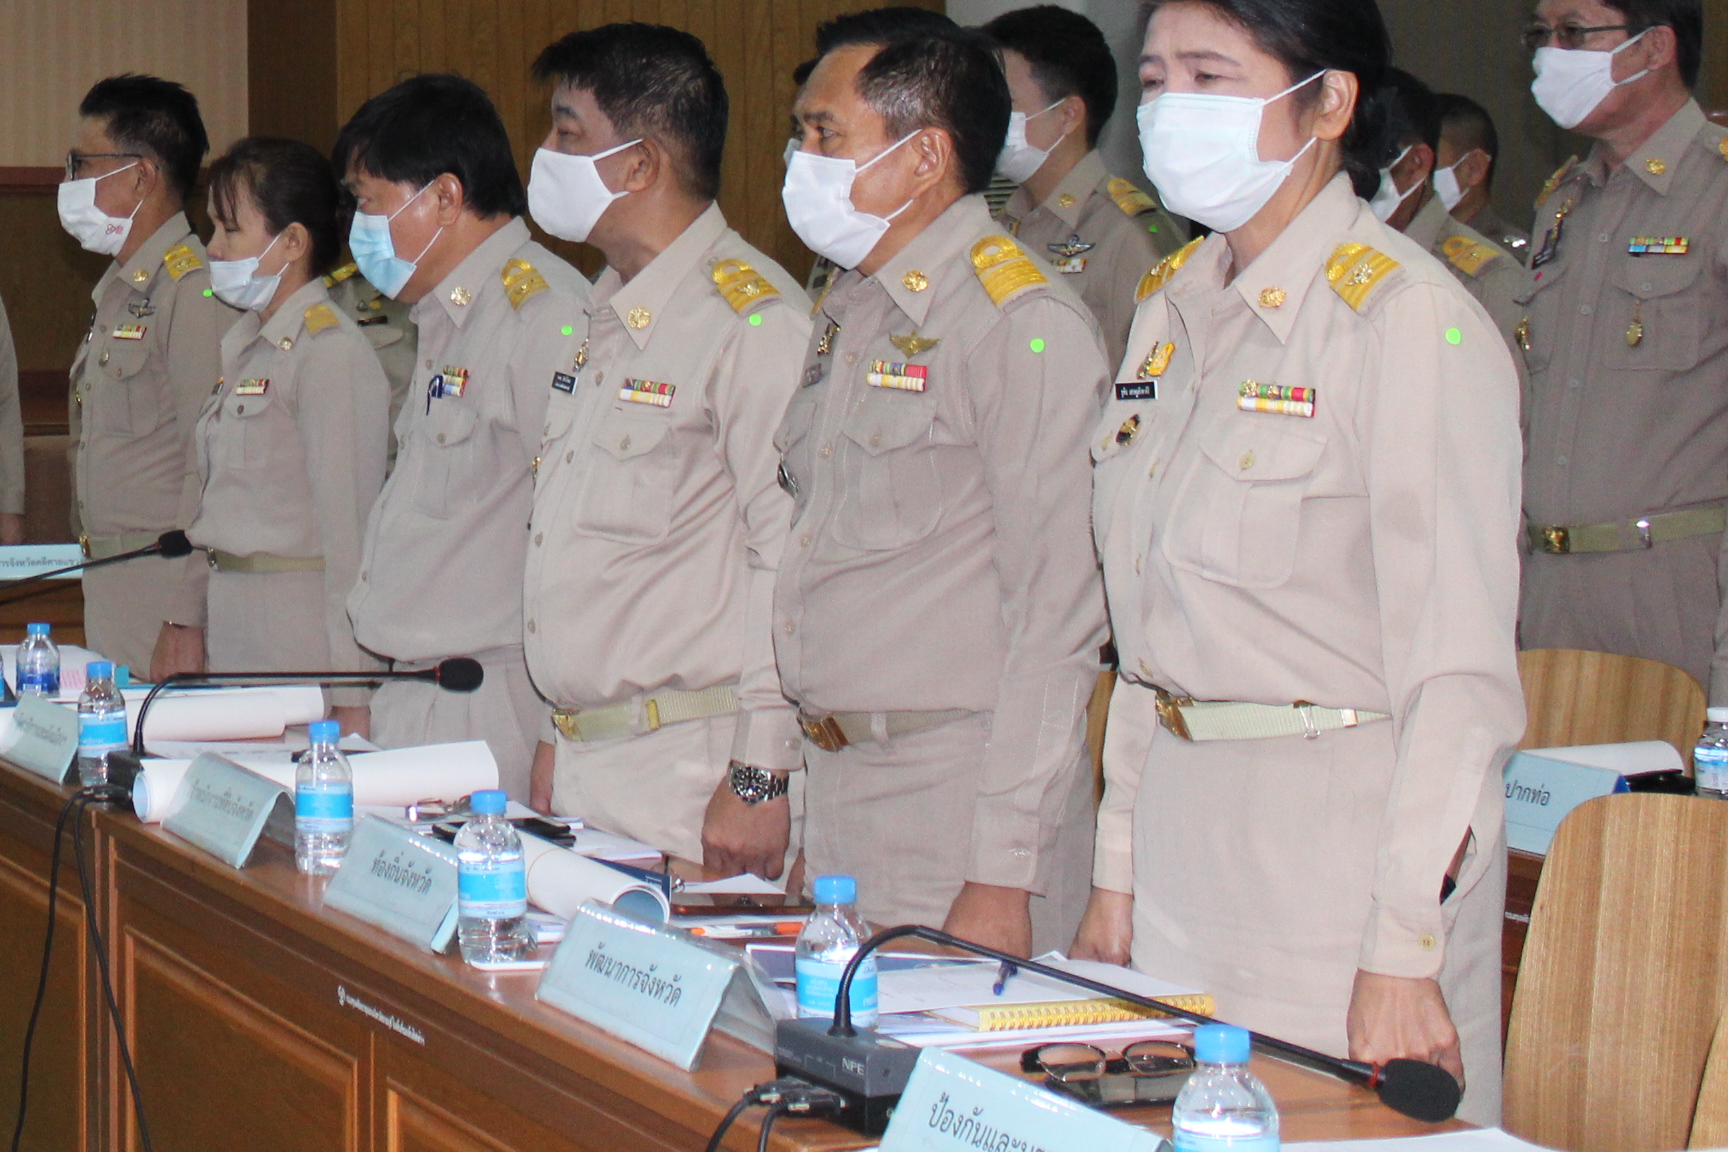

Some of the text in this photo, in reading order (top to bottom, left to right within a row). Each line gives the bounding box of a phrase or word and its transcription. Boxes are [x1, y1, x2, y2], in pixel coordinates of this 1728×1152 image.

[371, 850, 432, 895] ท้องถิ่นจังหวัด
[585, 941, 682, 1007] พัฒนาการจังหวัด
[842, 1057, 865, 1076] NPE
